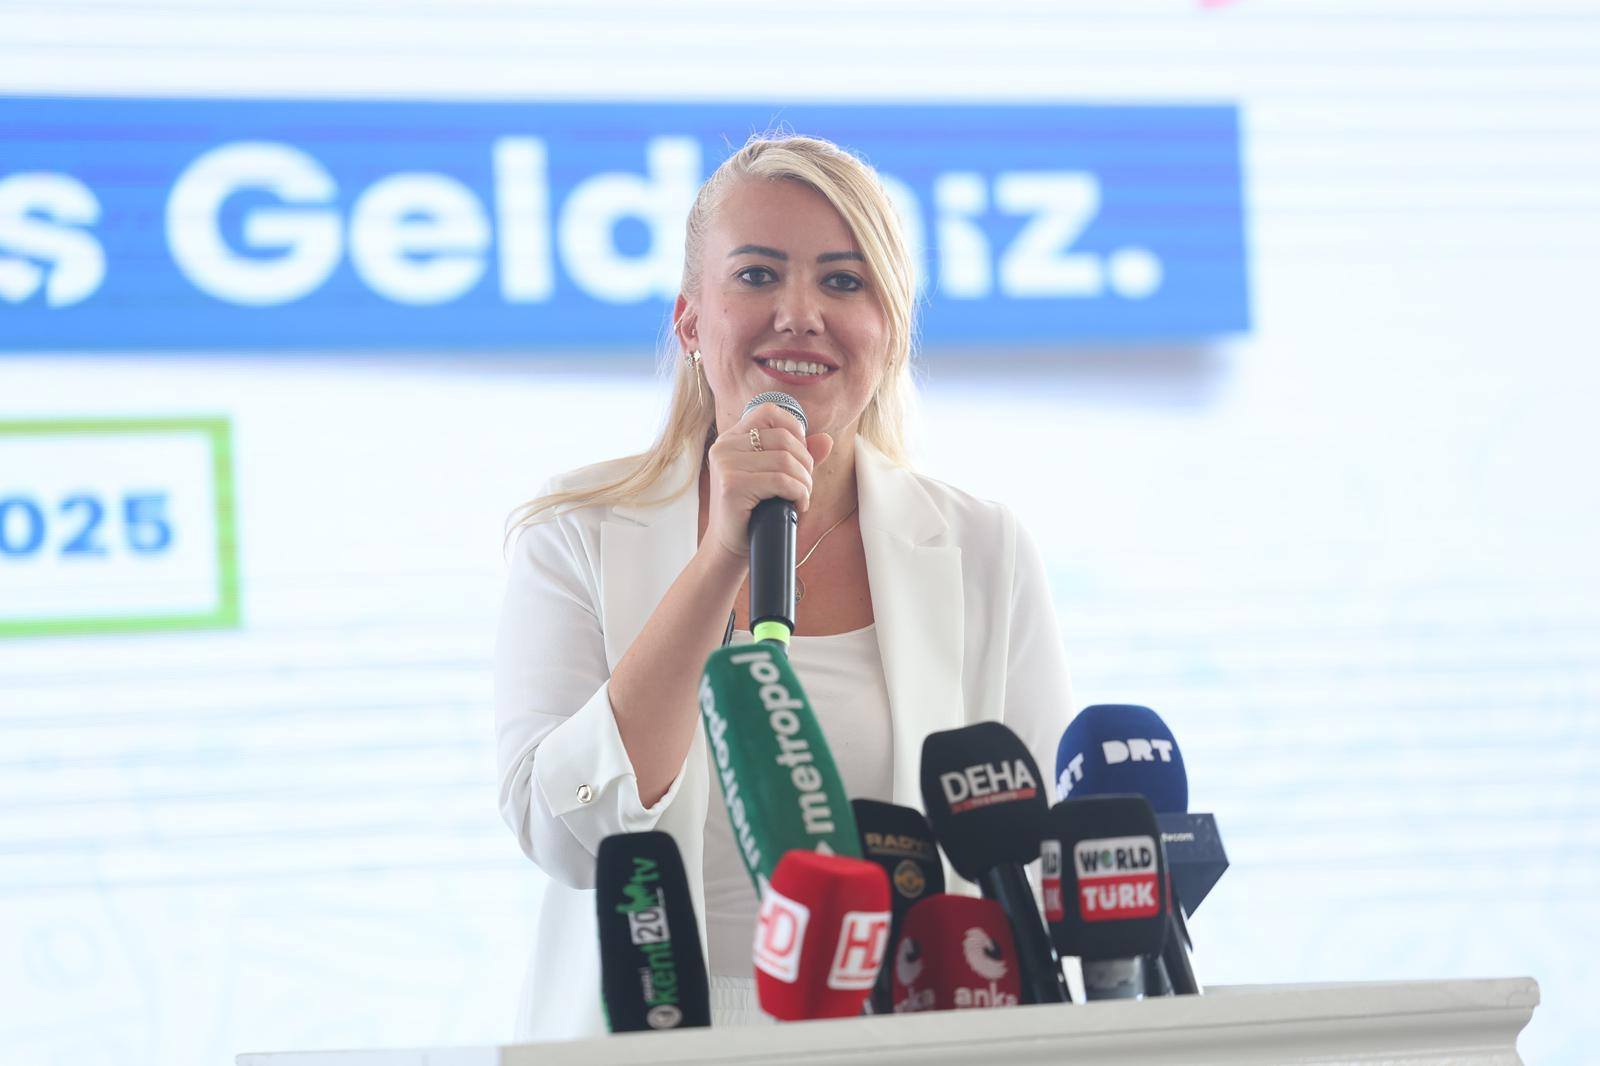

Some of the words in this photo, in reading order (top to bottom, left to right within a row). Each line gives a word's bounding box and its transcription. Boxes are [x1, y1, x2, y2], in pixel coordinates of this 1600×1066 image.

[164, 135, 1163, 307] Geldiz.
[732, 651, 836, 836] metropol
[1102, 738, 1173, 765] DRT
[939, 759, 1037, 804] DEHA
[1080, 846, 1152, 872] WORLD
